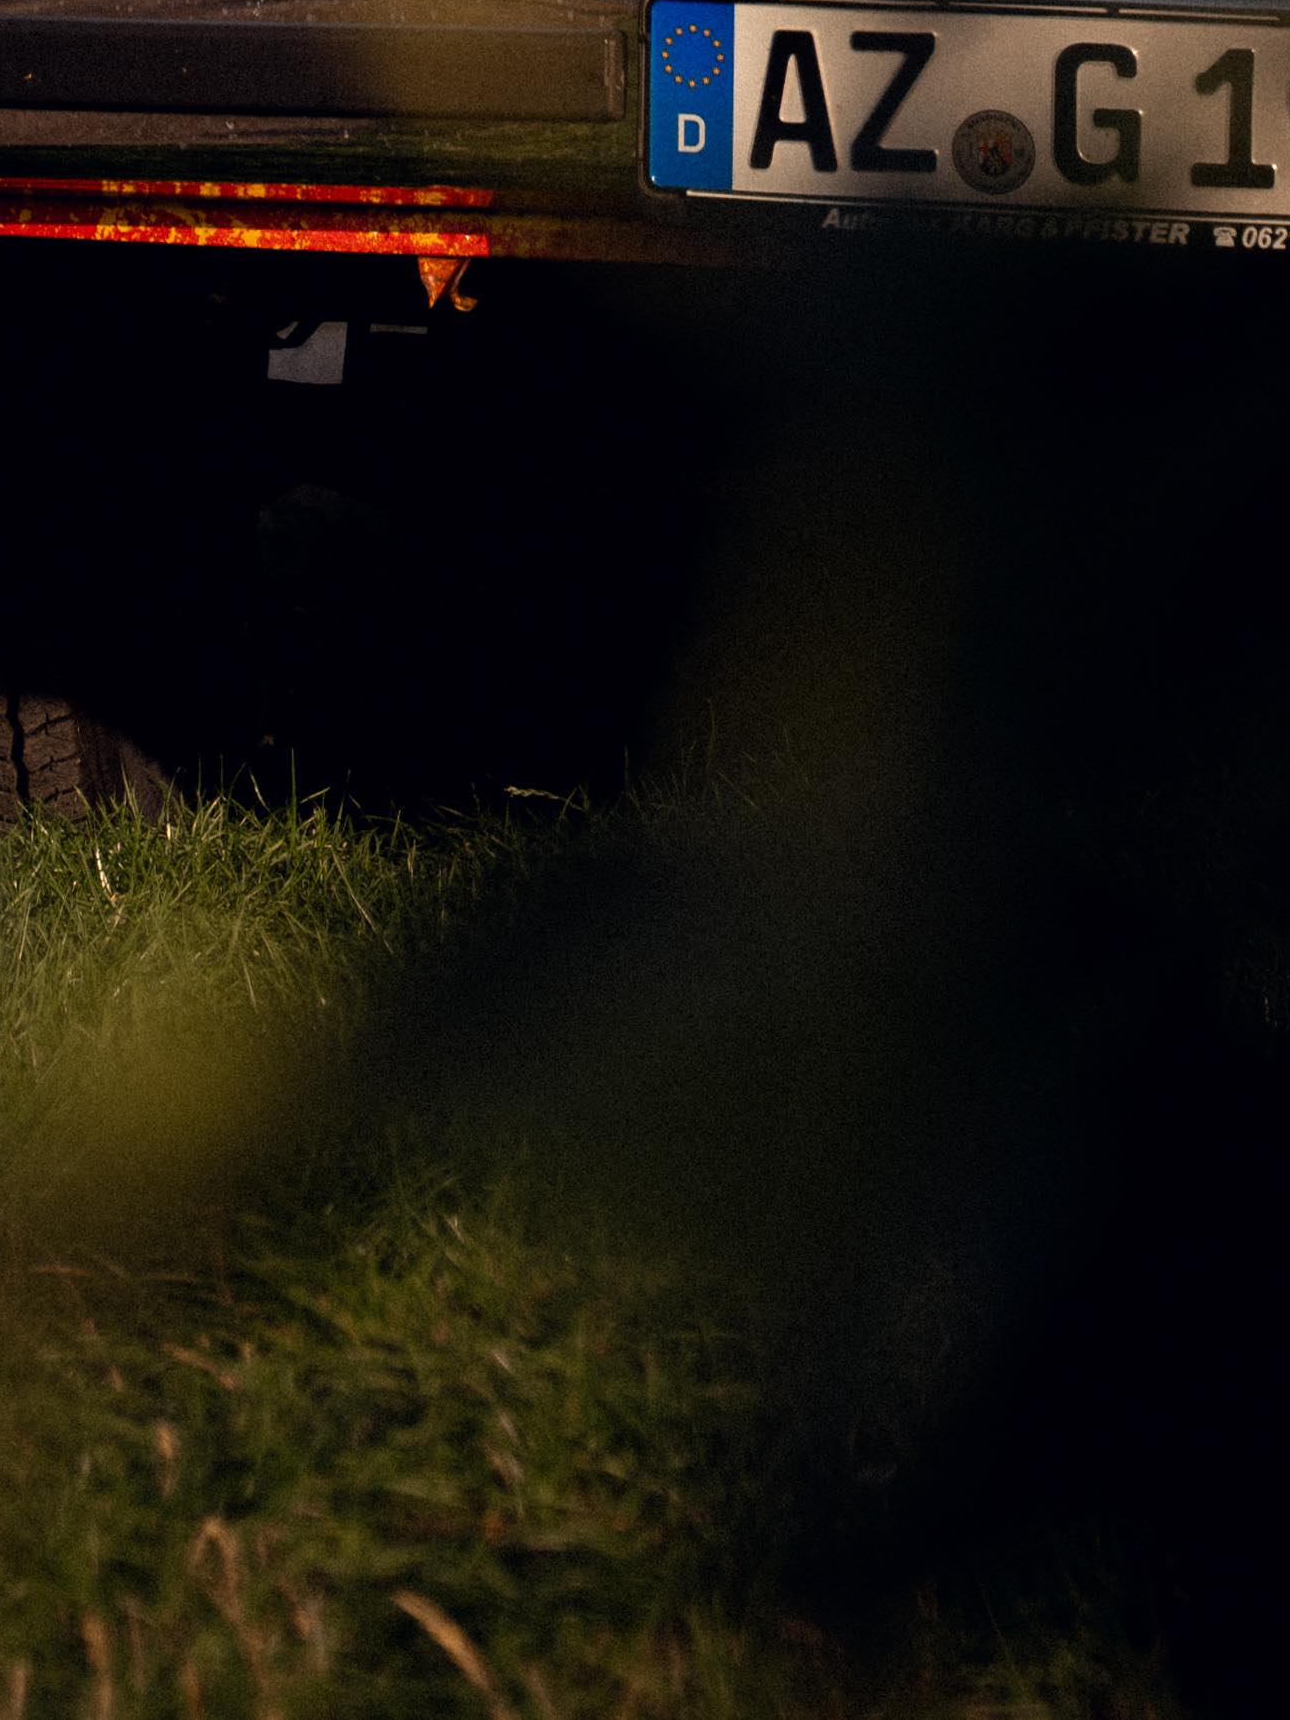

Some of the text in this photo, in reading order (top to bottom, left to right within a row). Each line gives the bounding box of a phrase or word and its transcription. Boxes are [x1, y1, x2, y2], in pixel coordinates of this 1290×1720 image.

[677, 112, 707, 153] D
[749, 29, 938, 173] AZ
[1051, 41, 1142, 187] G
